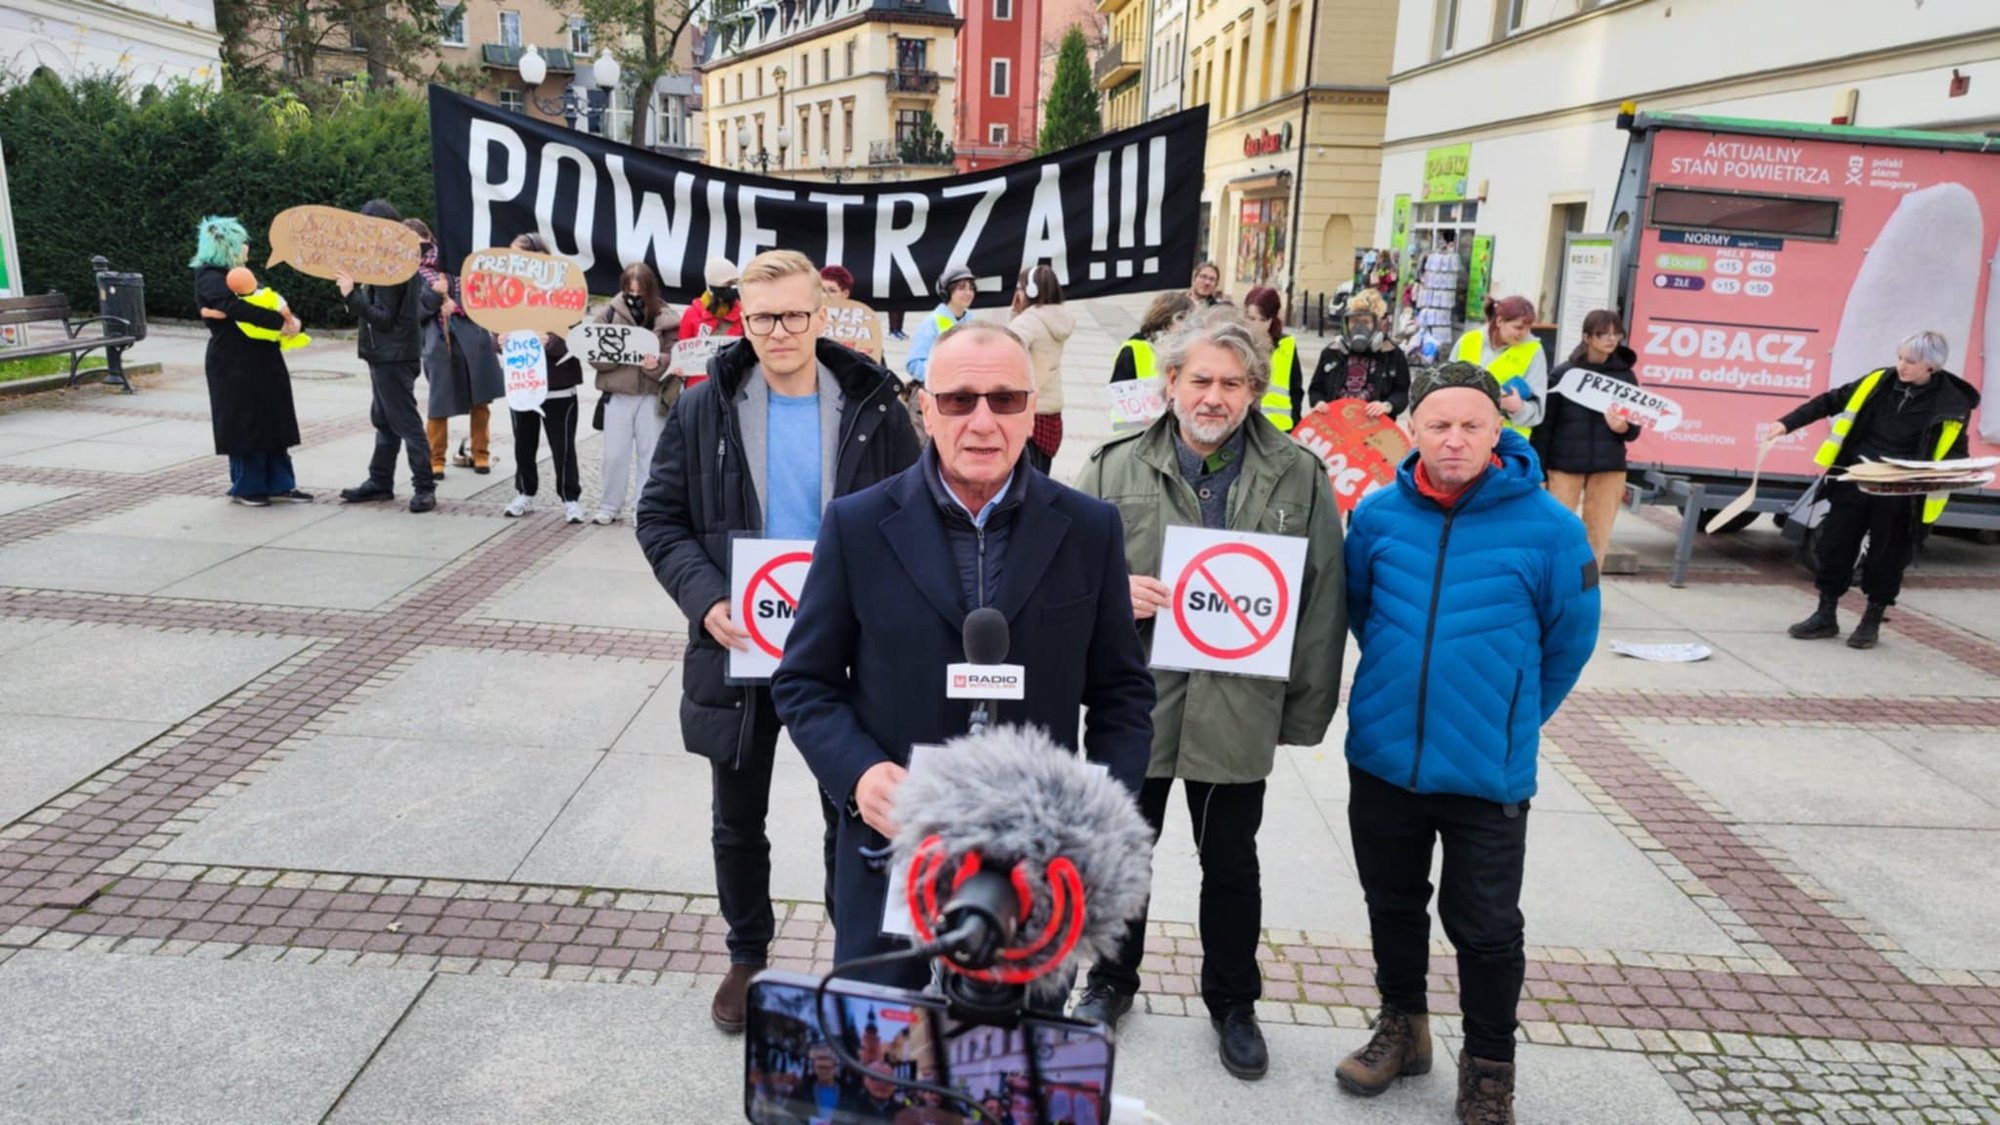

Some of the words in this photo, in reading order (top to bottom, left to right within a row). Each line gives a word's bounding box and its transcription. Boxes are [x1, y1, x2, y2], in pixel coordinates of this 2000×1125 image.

[1703, 141, 1803, 163] AKTUALNY
[1670, 157, 1718, 175] STAN
[1724, 161, 1831, 184] POWIETRZA
[1870, 168, 1900, 179] alarm
[1871, 158, 1904, 170] polski
[1869, 179, 1919, 191] smogowy
[467, 118, 1167, 299] POWIETRZA!!!
[1684, 232, 1731, 246] NORMY
[466, 272, 524, 309] EKO
[585, 327, 631, 341] STOP
[1644, 325, 1815, 369] ZOBACZ,
[1642, 364, 1694, 384] czym
[1699, 367, 1812, 389] oddychasz!
[1664, 431, 1736, 445] FOUNDATION
[758, 599, 797, 619] SM
[1188, 590, 1273, 618] SMOG
[968, 674, 1018, 684] RADIO
